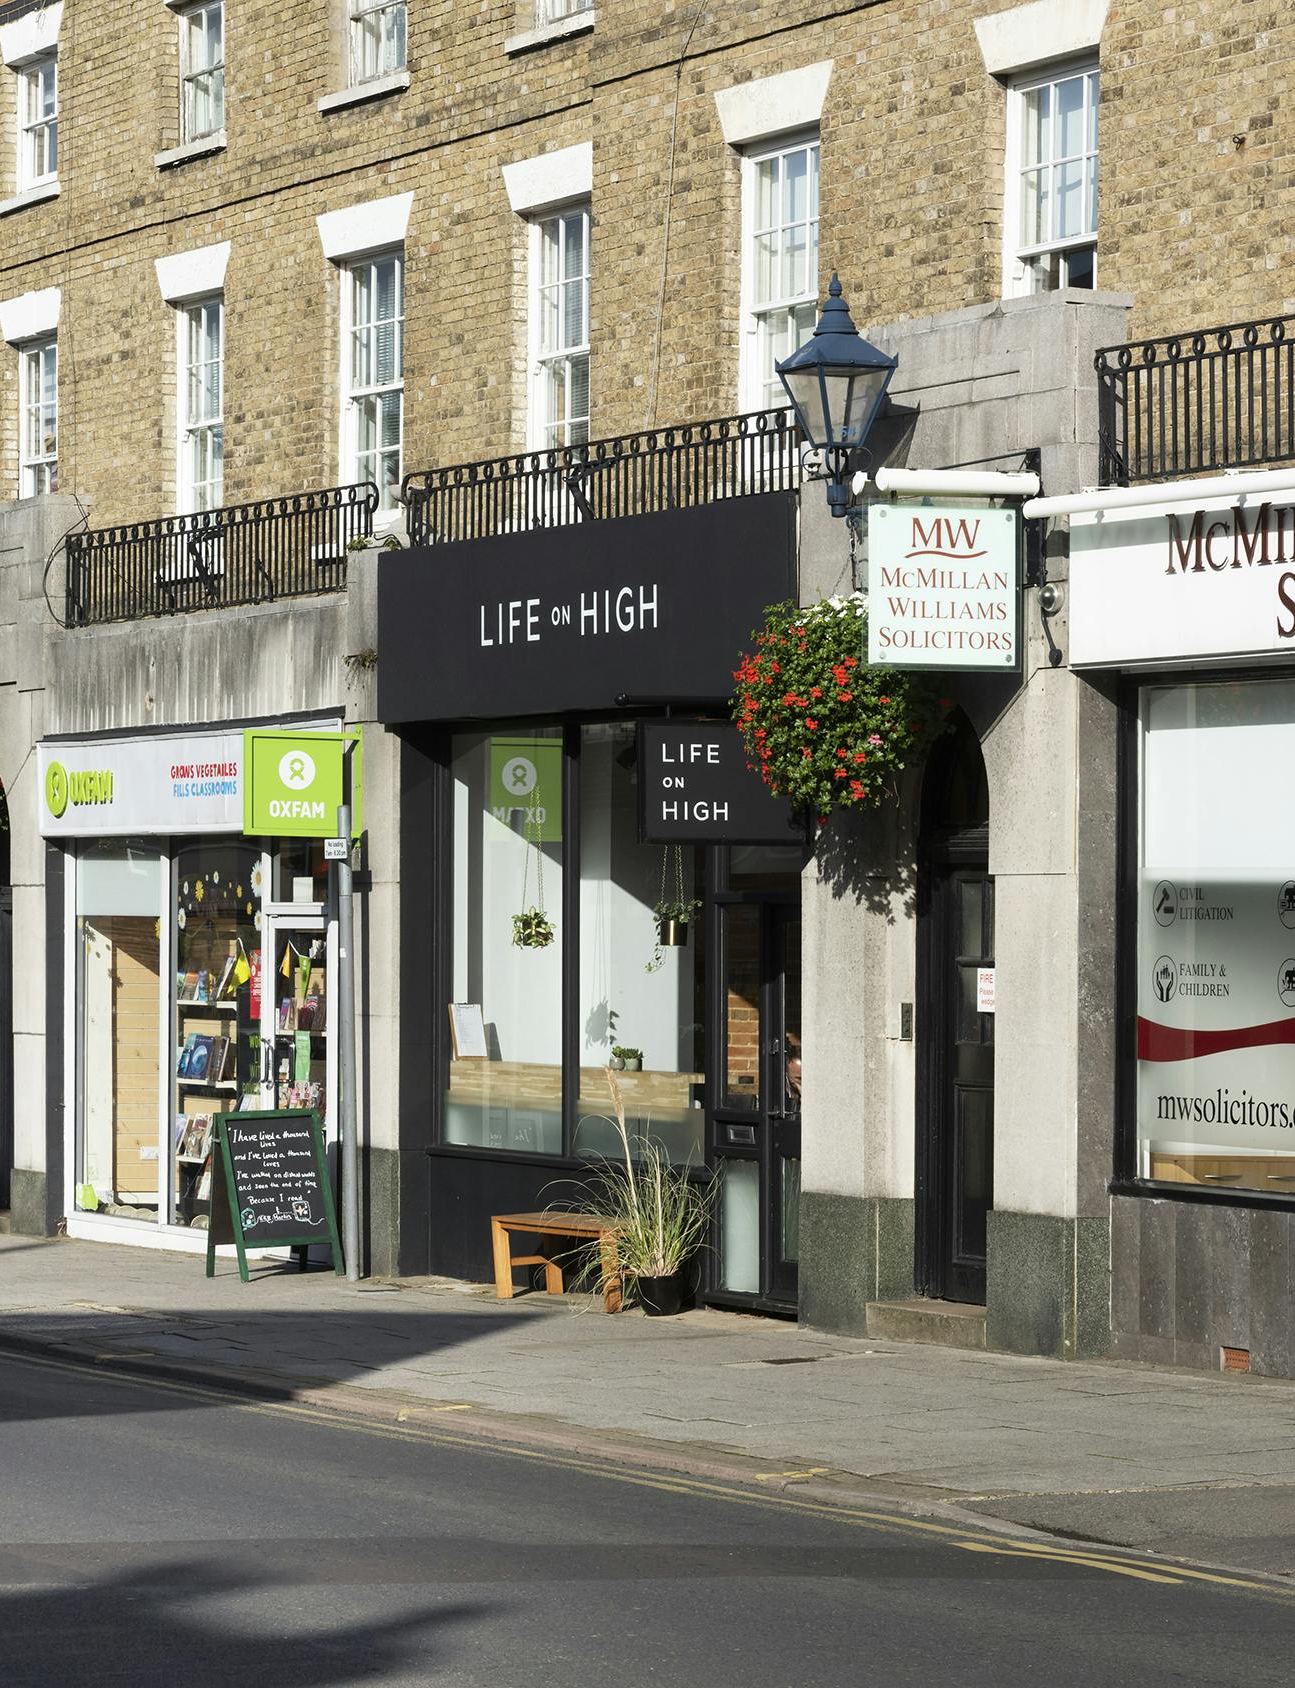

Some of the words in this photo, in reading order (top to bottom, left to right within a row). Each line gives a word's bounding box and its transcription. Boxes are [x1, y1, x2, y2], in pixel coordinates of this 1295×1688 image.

[912, 517, 981, 550] MW
[480, 599, 541, 647] LIFE
[551, 605, 571, 626] ON
[580, 584, 658, 636] HIGH
[662, 743, 720, 764] LIFE
[171, 765, 194, 779] GROWS
[196, 762, 237, 778] VEGETABLES
[173, 782, 190, 797] FILLS
[191, 780, 237, 796] CLASSROOMS
[662, 777, 685, 788] ON
[269, 800, 325, 819] OXFAM
[662, 801, 729, 821] HIGH
[1179, 888, 1204, 901] CIVIL
[1179, 907, 1234, 920] LITIGATION
[1179, 963, 1217, 977] FAMILY
[1219, 964, 1226, 977] &
[1178, 982, 1230, 997] CHILDREN
[1157, 1088, 1295, 1129] mwsolicitors.
[237, 1129, 258, 1142] have
